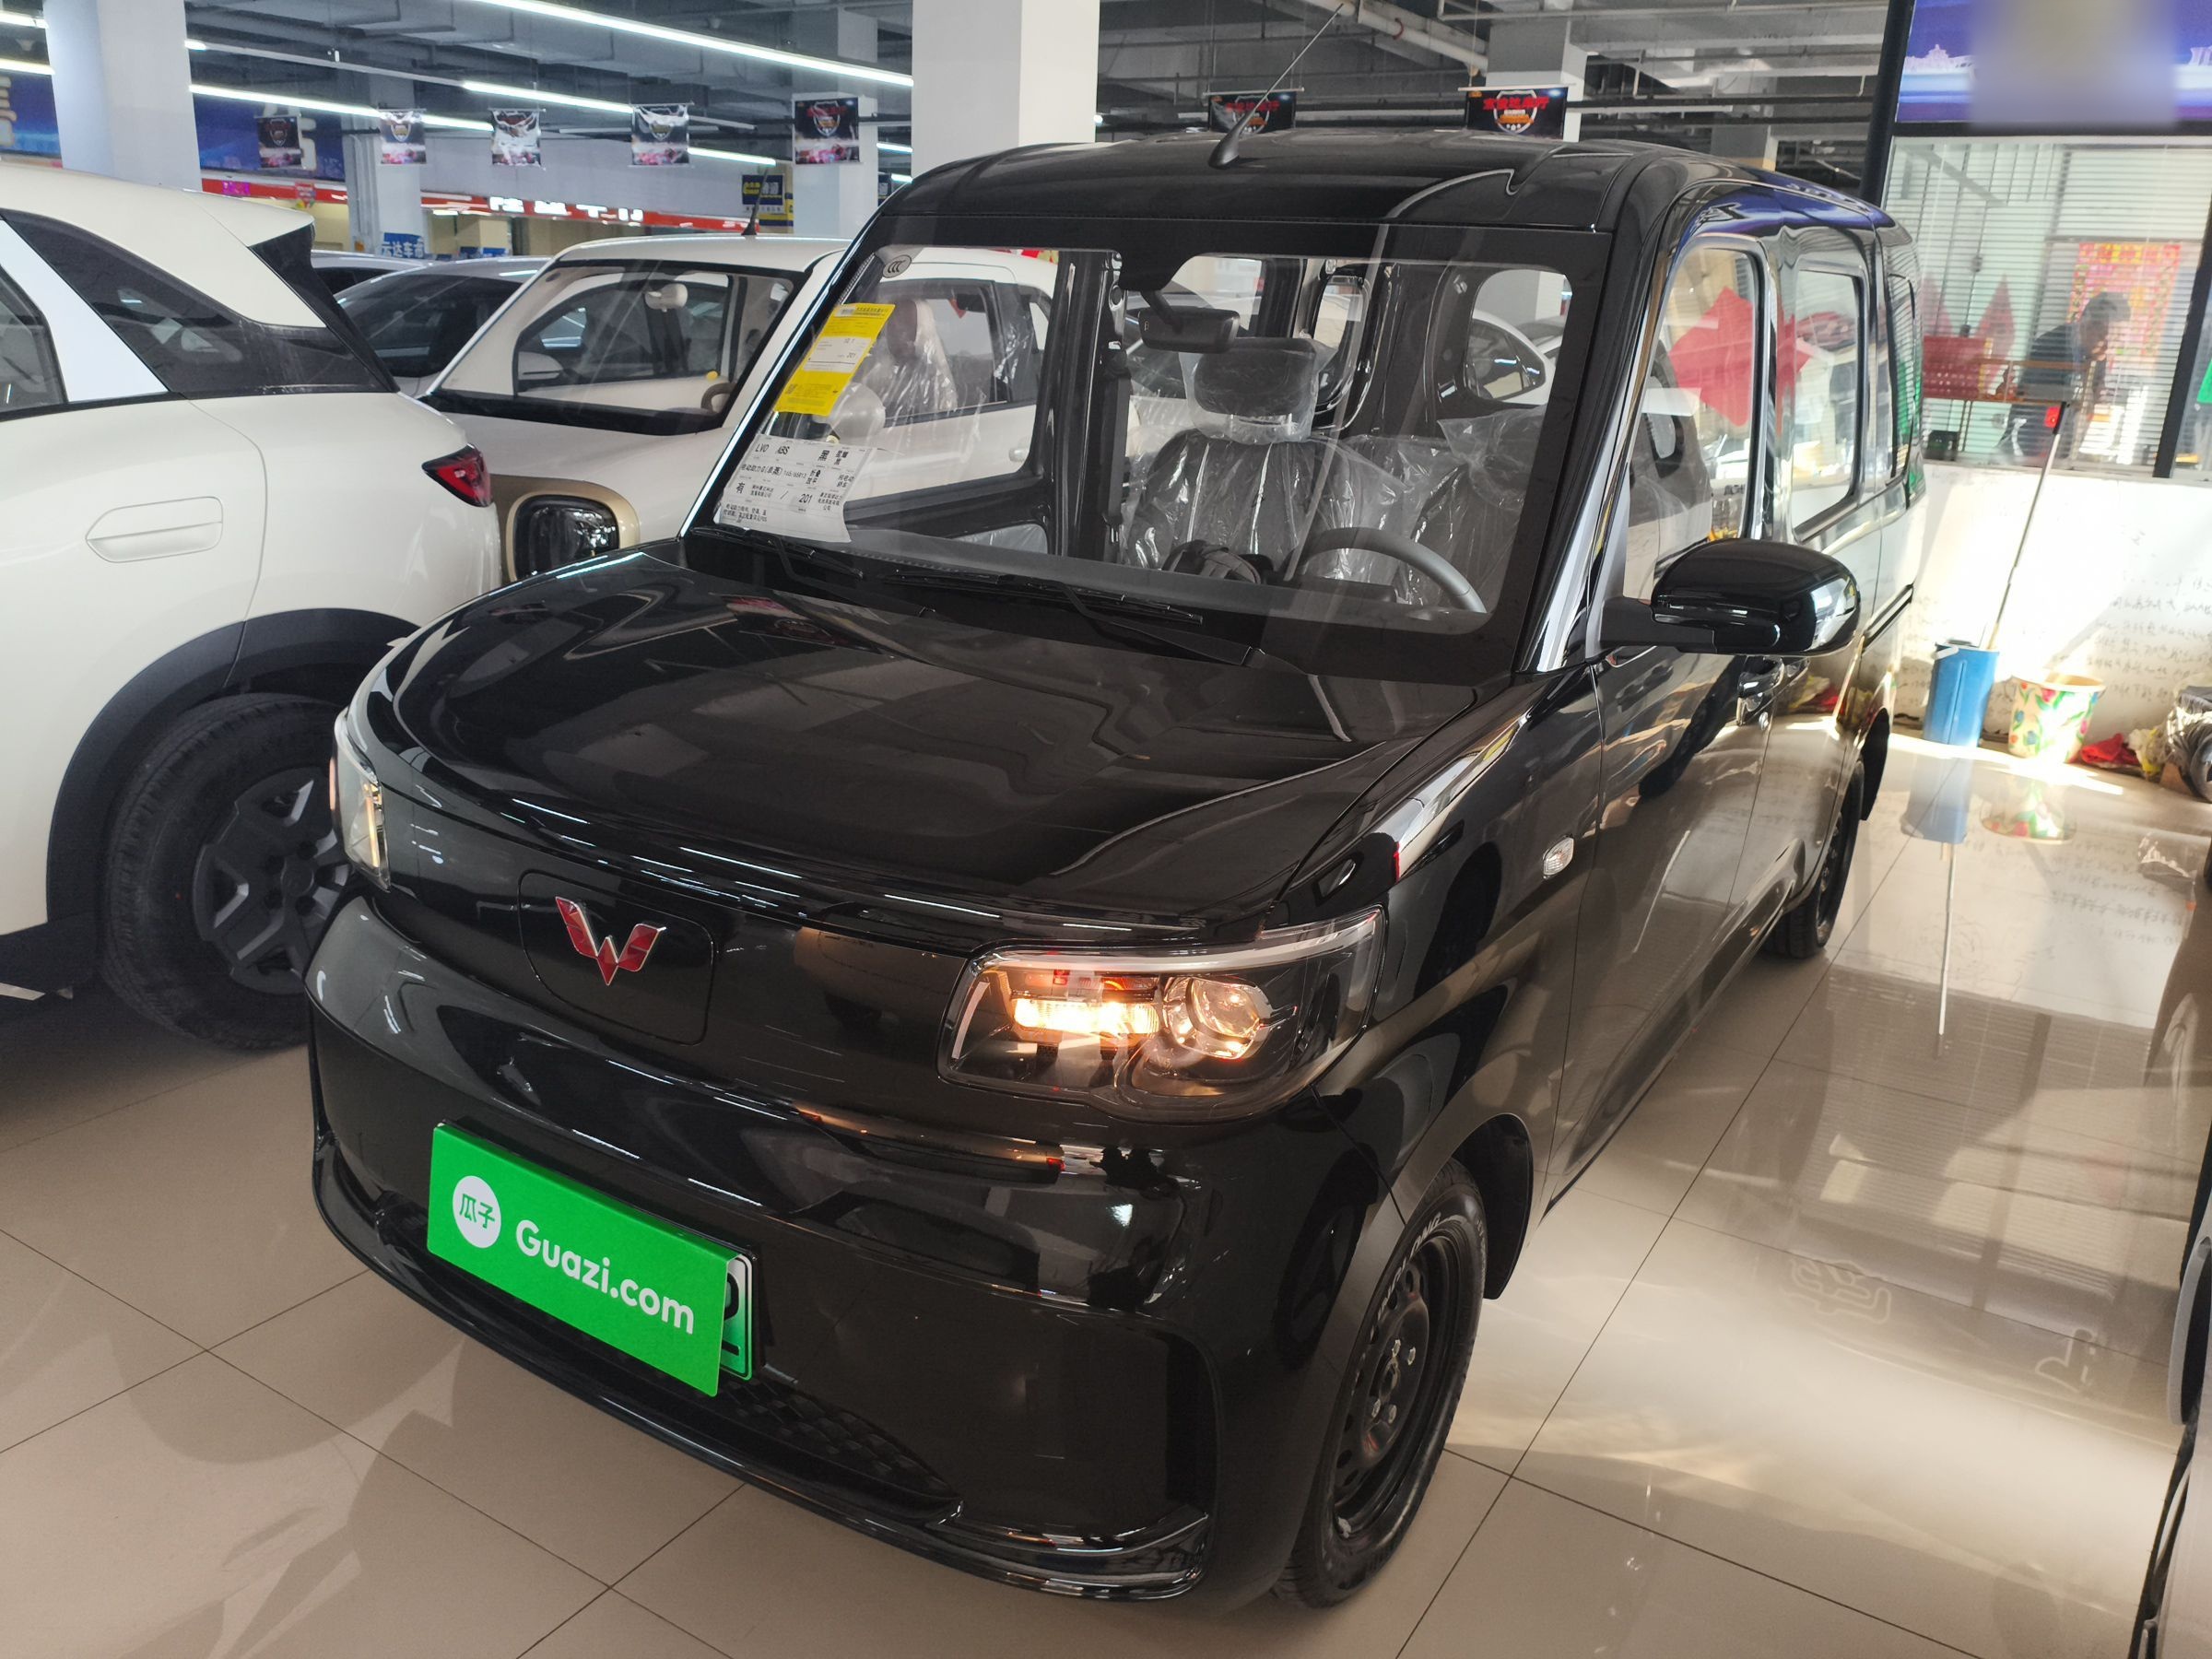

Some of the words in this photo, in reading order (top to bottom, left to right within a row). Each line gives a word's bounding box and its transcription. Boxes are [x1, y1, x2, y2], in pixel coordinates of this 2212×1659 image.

[798, 492, 813, 504] 201
[459, 1192, 495, 1230] 瓜子
[515, 1218, 694, 1335] Guazi.com
